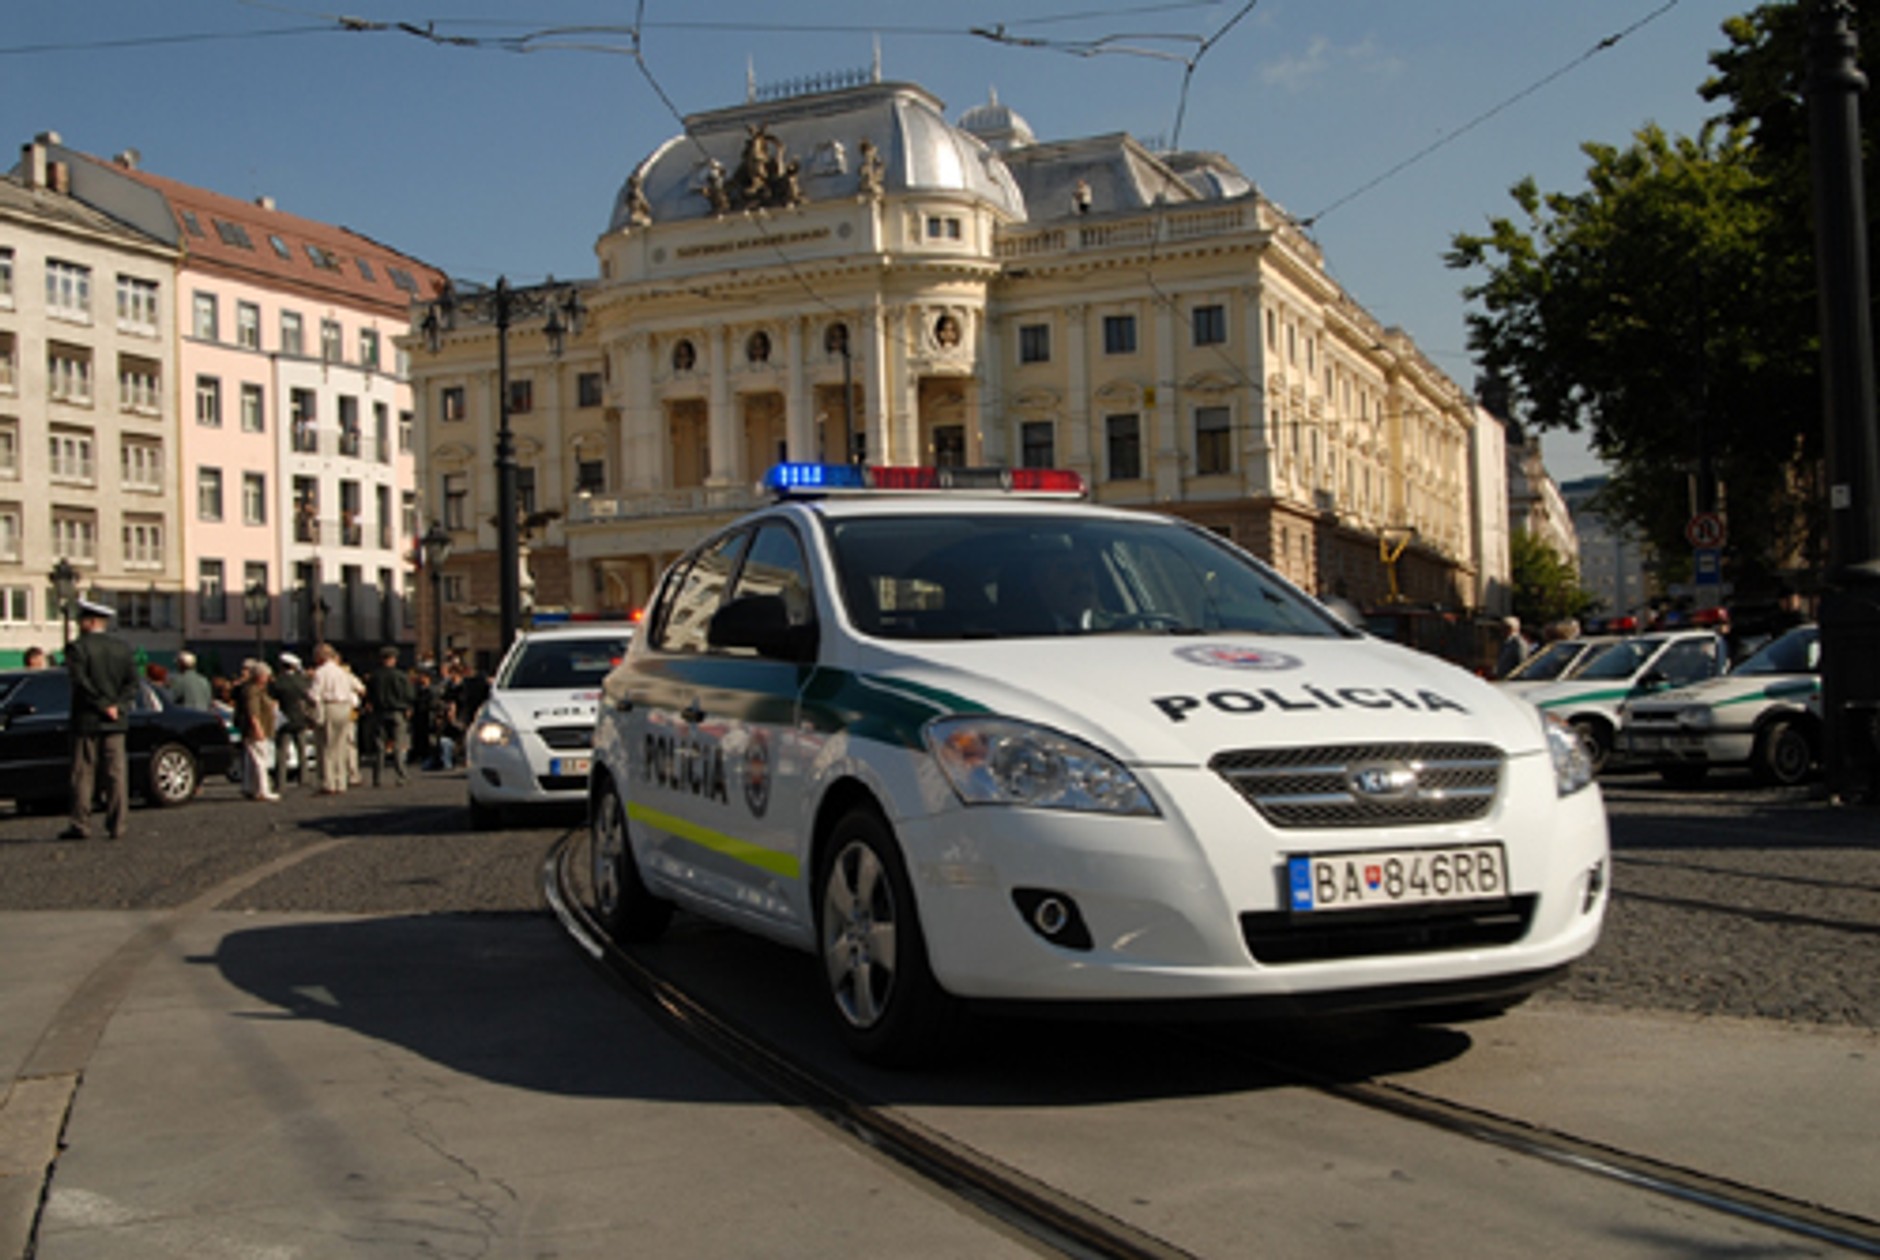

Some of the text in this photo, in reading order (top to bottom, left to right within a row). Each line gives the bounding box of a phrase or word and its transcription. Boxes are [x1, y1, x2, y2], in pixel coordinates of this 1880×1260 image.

[1151, 683, 1473, 723] POLÍCIA
[1315, 852, 1499, 904] BA 846RB
